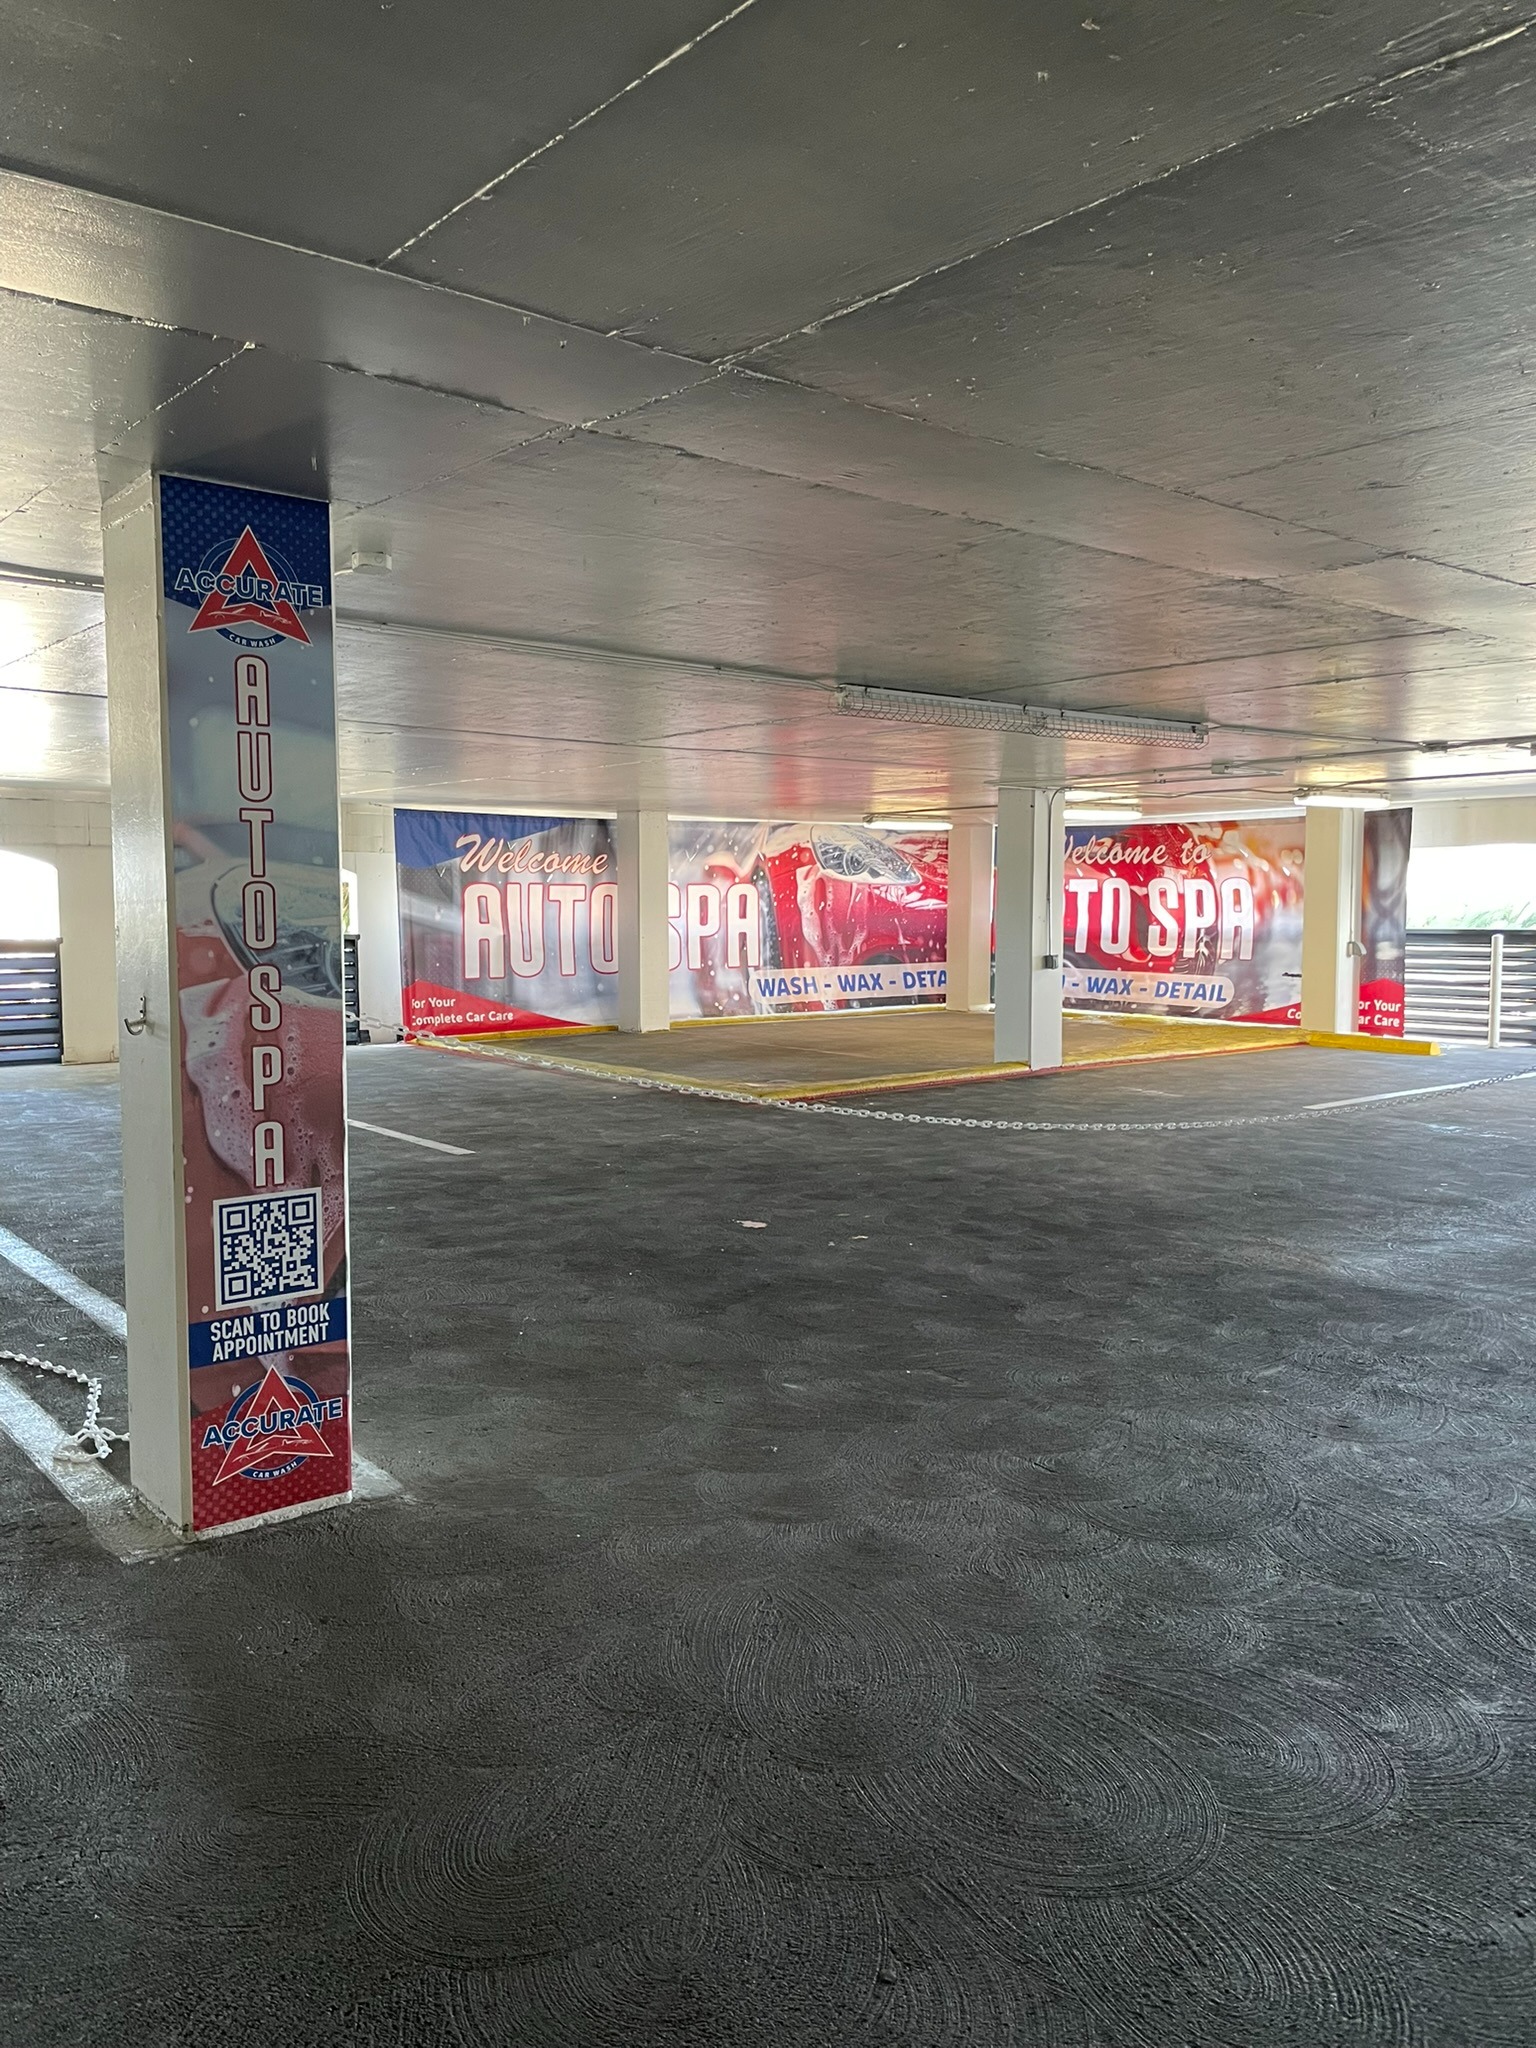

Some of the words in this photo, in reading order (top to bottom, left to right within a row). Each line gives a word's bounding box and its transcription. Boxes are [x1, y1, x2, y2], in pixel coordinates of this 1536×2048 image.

[175, 568, 323, 608] ACCURATE
[229, 633, 247, 646] CAR
[249, 637, 276, 648] WASH
[235, 654, 277, 951] AUTO
[455, 833, 609, 875] Welcome
[1064, 834, 1168, 866] elcome
[1180, 838, 1212, 864] to
[463, 881, 619, 980] AUTO
[1147, 877, 1255, 961] SPA
[757, 975, 819, 998] WASH
[838, 973, 884, 993] WAX
[903, 970, 947, 989] DETA
[1087, 976, 1134, 995] WAX
[1154, 980, 1227, 1003] DETAIL
[428, 997, 456, 1008] Your
[466, 1011, 486, 1022] Car
[488, 1010, 514, 1021] Care
[1358, 1000, 1371, 1010] or
[1374, 999, 1402, 1013] Your
[1358, 1015, 1371, 1025] ar
[1374, 1014, 1400, 1028] Care
[247, 963, 285, 1188] SPA
[210, 1315, 255, 1342] SCAN
[260, 1311, 281, 1332] TO
[286, 1302, 331, 1328] BOOK
[212, 1322, 329, 1363] APPOINTMENT
[201, 1397, 343, 1449] ACCURATE
[252, 1469, 270, 1479] CAR
[272, 1460, 299, 1478] WASH
